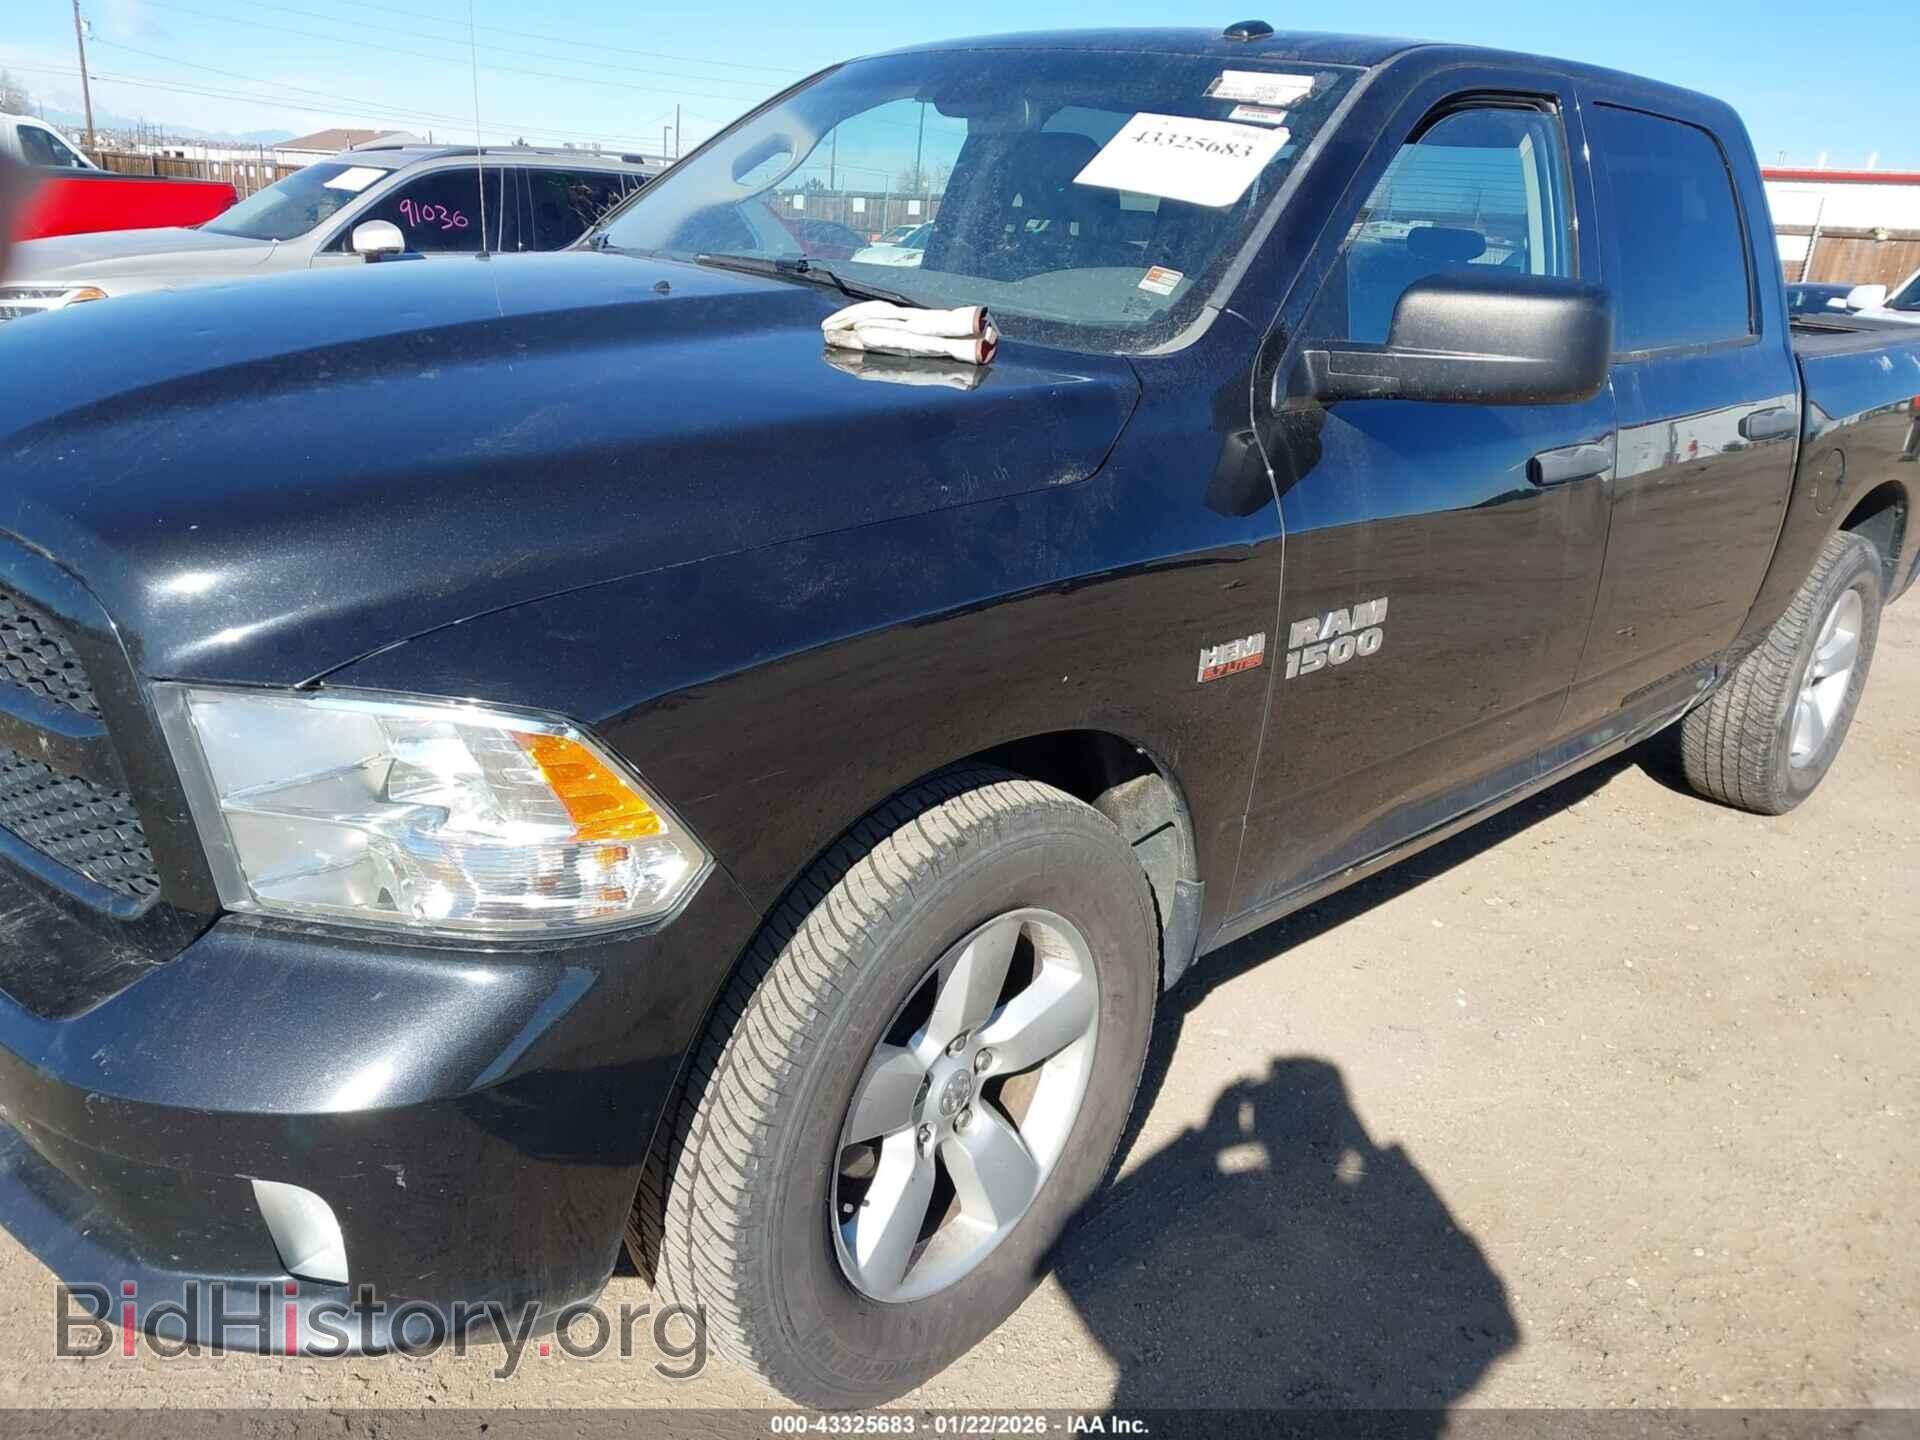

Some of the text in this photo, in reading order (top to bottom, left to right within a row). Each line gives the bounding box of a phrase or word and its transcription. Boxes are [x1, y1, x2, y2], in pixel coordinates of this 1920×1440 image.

[1131, 130, 1254, 159] 43325683
[399, 199, 469, 230] 91036
[1288, 597, 1389, 650] RAM
[1199, 632, 1266, 669] HEMI
[1285, 627, 1384, 680] 1500
